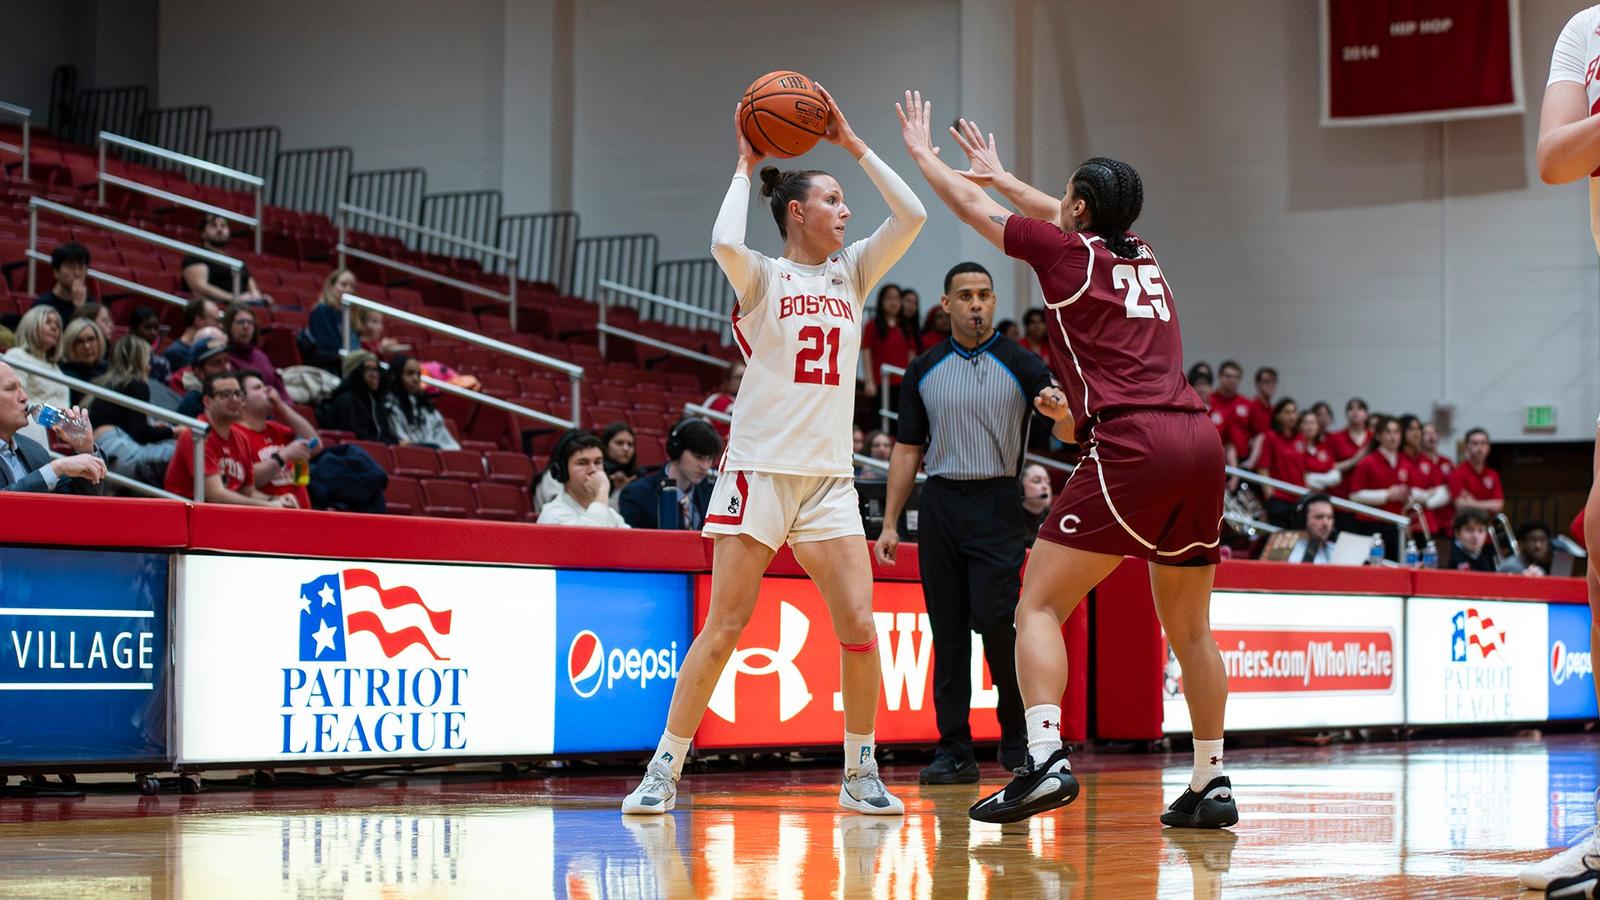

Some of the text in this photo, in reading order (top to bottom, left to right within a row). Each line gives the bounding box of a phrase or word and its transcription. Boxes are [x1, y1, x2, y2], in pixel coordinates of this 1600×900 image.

[1389, 17, 1454, 36] HIP HOP
[778, 76, 808, 90] THE
[779, 295, 855, 322] BOSTON
[1112, 264, 1171, 322] 25
[794, 325, 841, 386] 21
[1059, 513, 1082, 534] C
[11, 630, 154, 669] VILLAGE
[607, 640, 678, 689] pepsi
[1219, 640, 1393, 687] rriers.com/WhoWeAre
[280, 667, 469, 708] PATRIOT
[1444, 665, 1513, 690] PATRIOT
[280, 711, 468, 754] LEAGUE
